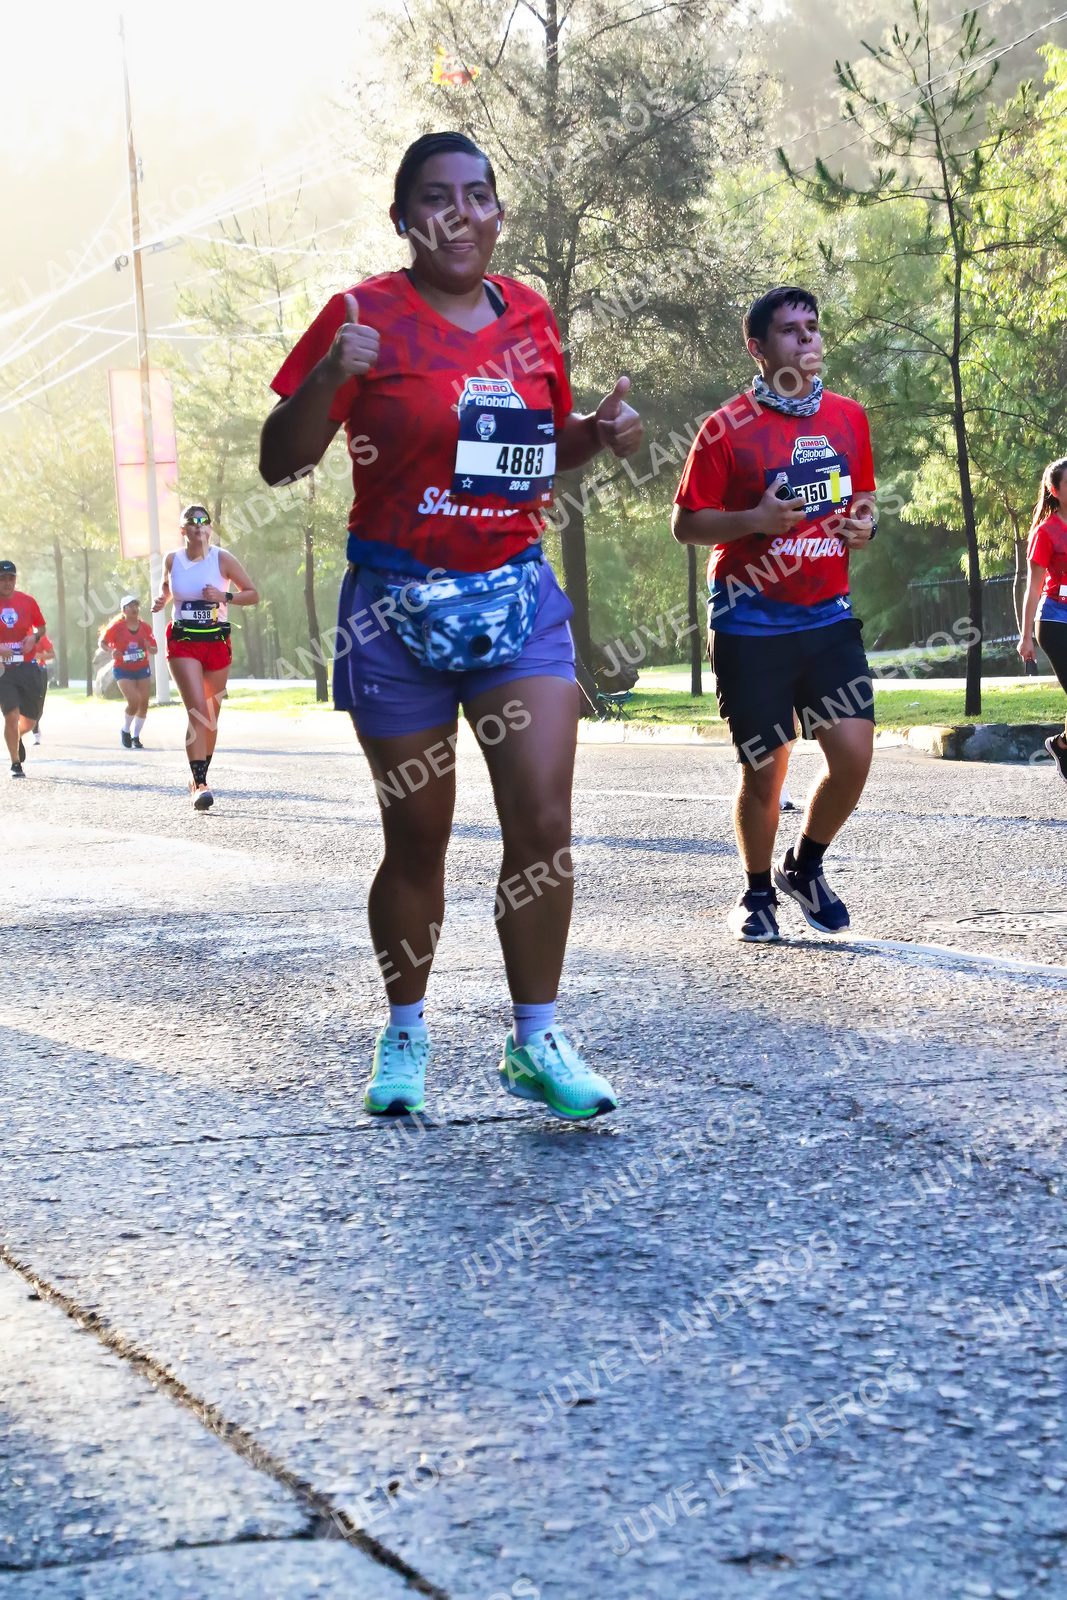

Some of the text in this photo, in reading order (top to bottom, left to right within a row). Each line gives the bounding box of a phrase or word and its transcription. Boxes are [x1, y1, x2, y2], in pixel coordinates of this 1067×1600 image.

[472, 384, 507, 393] BIMBO
[475, 395, 510, 408] Global
[802, 448, 826, 458] Global
[496, 446, 544, 475] 4883
[834, 507, 846, 515] 10K
[193, 611, 210, 619] 4538
